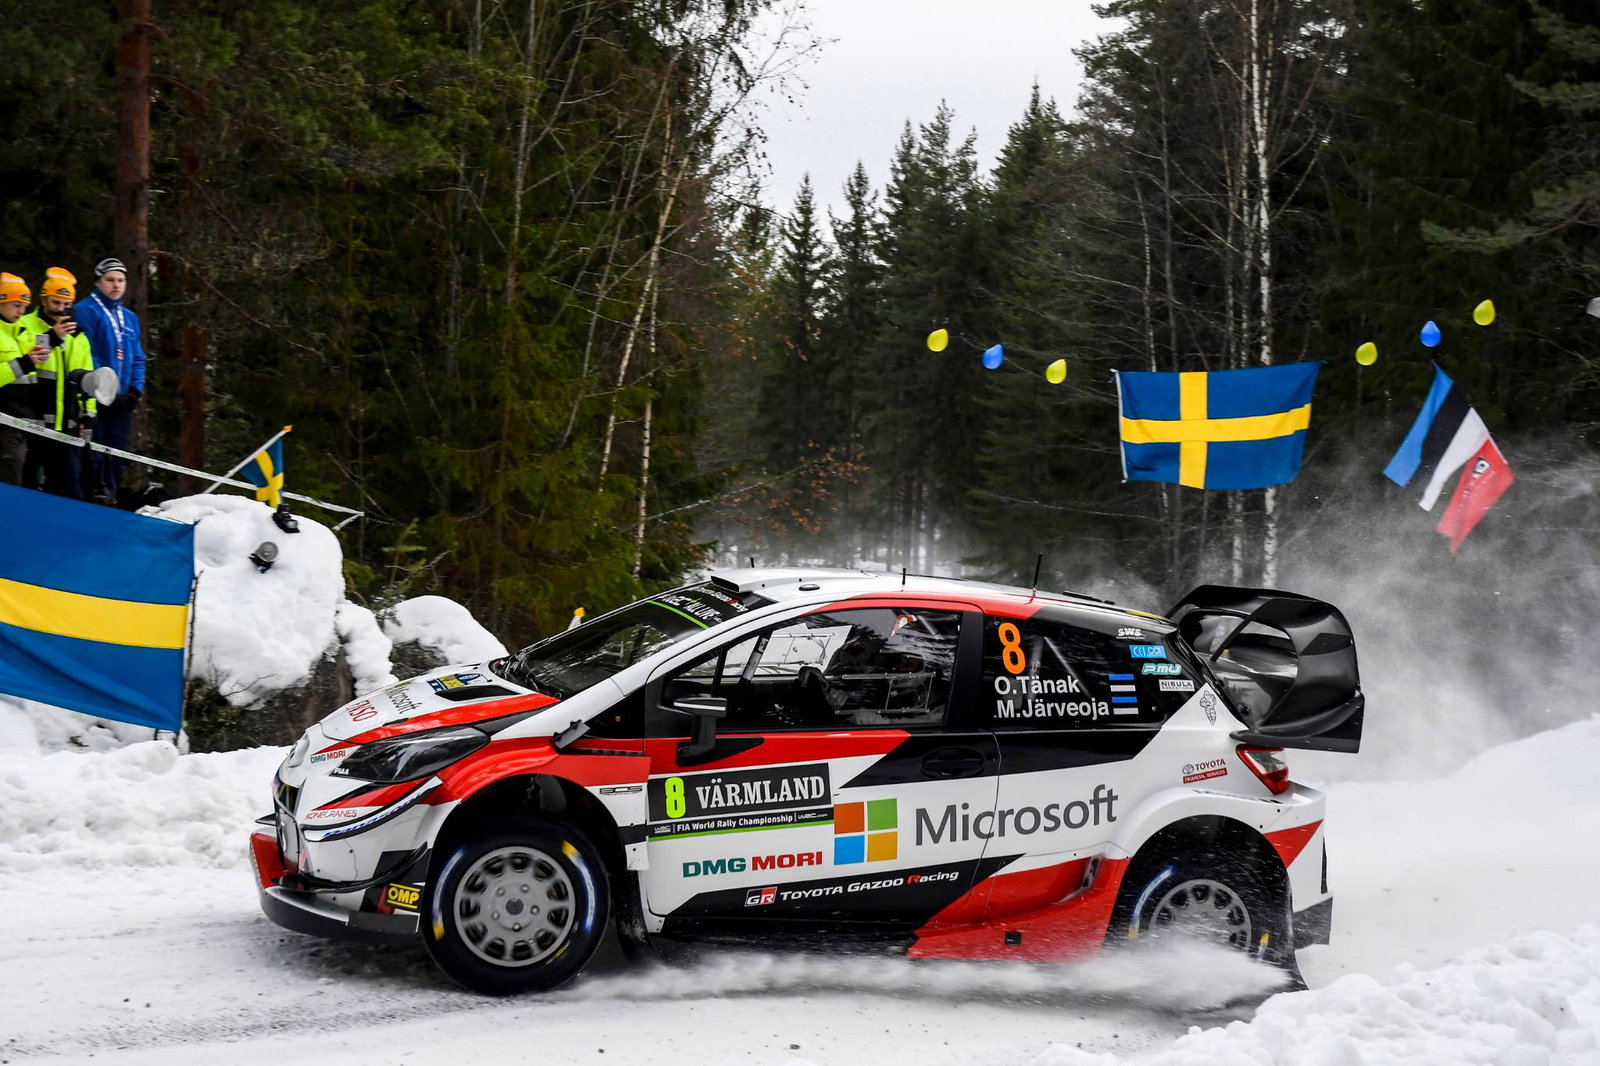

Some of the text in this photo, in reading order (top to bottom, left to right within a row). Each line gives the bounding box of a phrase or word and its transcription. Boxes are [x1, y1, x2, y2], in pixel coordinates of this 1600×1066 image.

[1117, 627, 1142, 637] SWS
[998, 622, 1026, 675] 8
[994, 675, 1081, 695] O.Tänak
[996, 697, 1110, 720] M.Järveoja
[310, 750, 346, 764] DMG MORI
[1195, 758, 1226, 772] TOYOTA
[333, 767, 350, 775] PIAA
[664, 775, 825, 819] 8 VÄRMLAND
[305, 809, 357, 820] KONECRANES
[677, 823, 691, 832] FIA
[692, 821, 715, 831] World
[717, 819, 737, 828] Rally
[738, 814, 793, 826] Championship
[915, 784, 1119, 846] Microsoft
[682, 851, 823, 878] DMG MORI
[388, 886, 420, 905] OMP
[780, 886, 844, 901] TOYOTA
[847, 877, 904, 893] GAZOO
[907, 871, 959, 885] Racing
